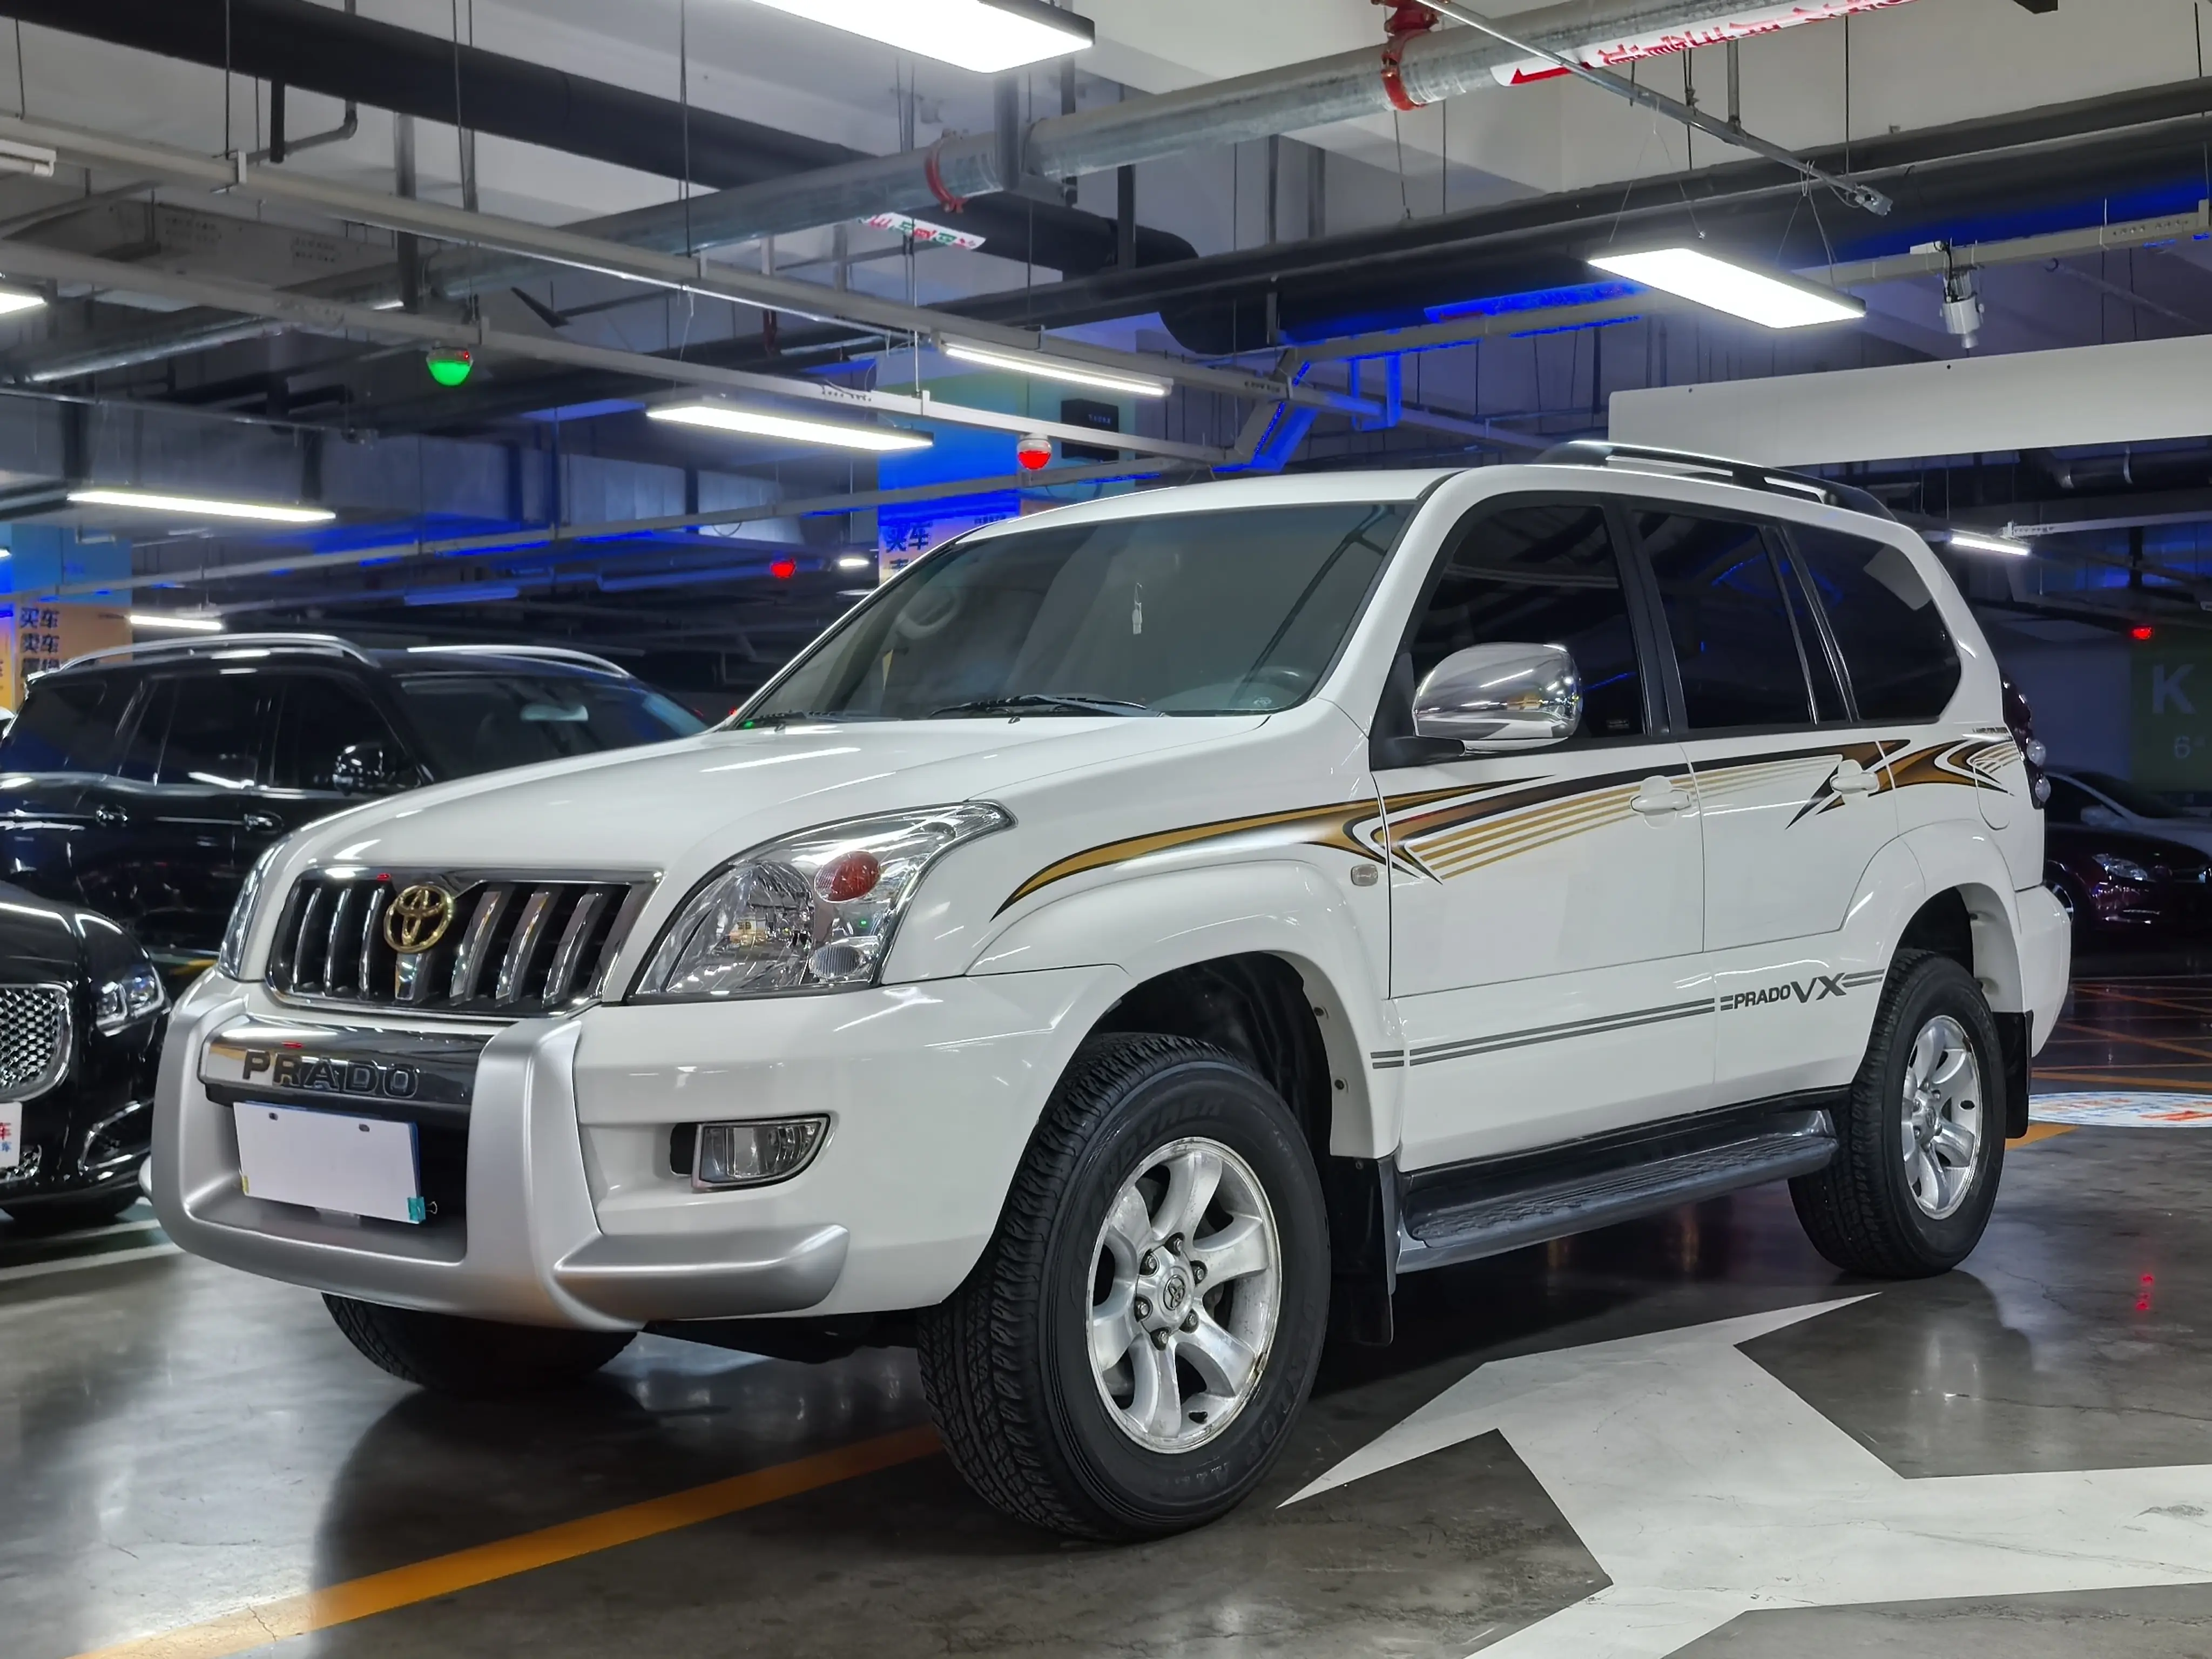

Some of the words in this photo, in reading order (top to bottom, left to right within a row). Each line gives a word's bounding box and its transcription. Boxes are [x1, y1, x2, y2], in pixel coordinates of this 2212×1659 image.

[20, 607, 60, 629] 买车
[22, 633, 60, 653] 卖车
[2152, 663, 2196, 715] K
[1734, 984, 1791, 1009] PRADO
[1790, 973, 1846, 1003] VX
[242, 1049, 420, 1098] PRADO
